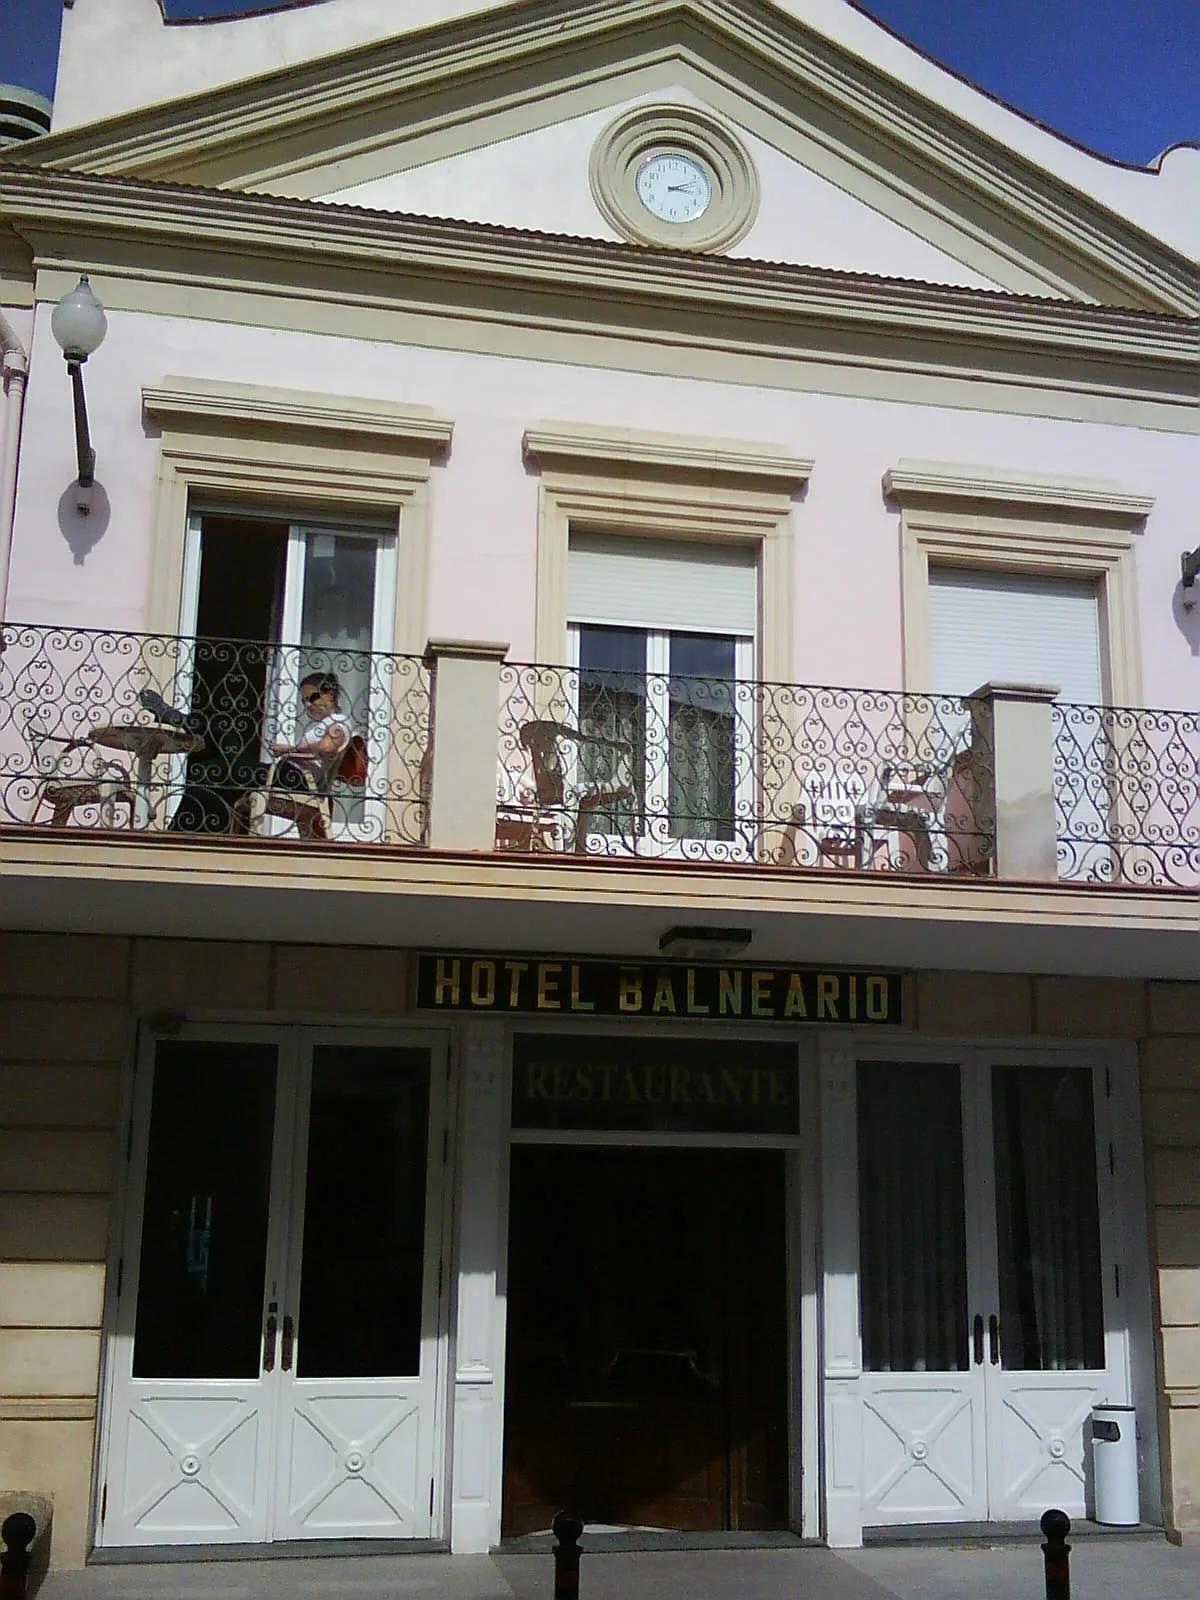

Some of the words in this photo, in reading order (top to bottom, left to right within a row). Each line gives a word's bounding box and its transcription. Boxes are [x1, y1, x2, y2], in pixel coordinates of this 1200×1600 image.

[435, 958, 595, 1010] HOTEL
[618, 966, 889, 1020] BALNEARIO
[525, 1061, 791, 1106] RESTAURANTE
